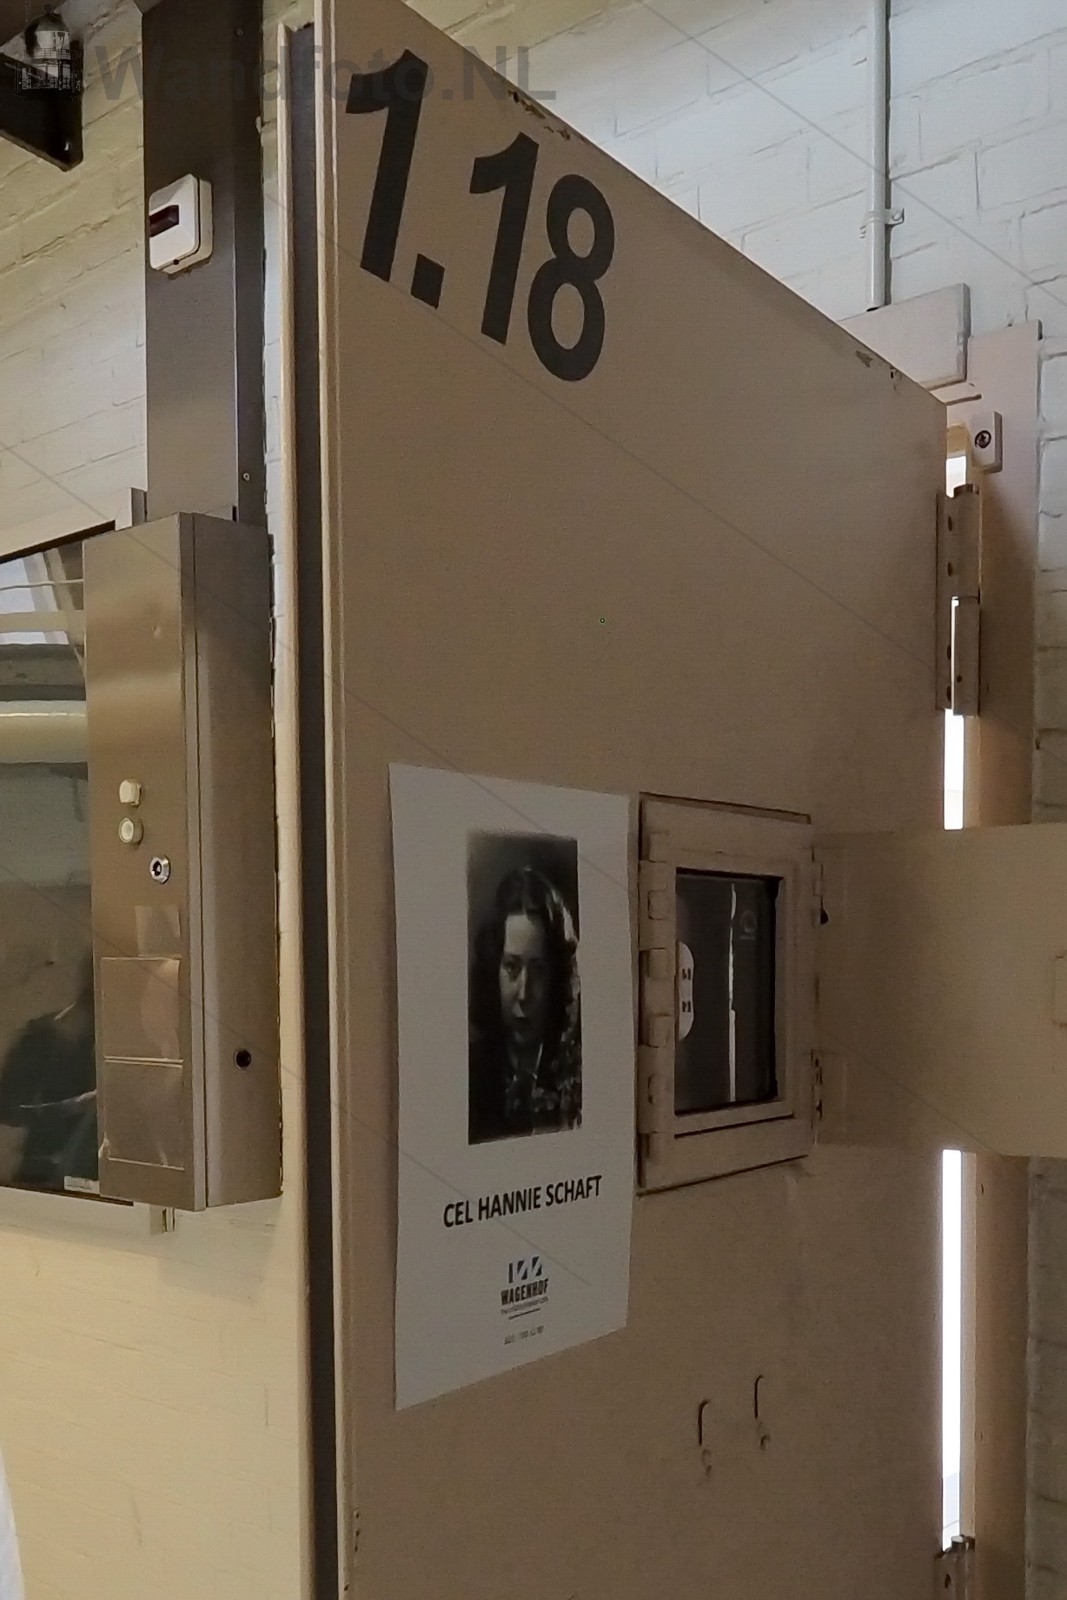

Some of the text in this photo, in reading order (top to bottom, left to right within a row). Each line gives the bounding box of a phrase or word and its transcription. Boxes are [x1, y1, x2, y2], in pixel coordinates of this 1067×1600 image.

[345, 48, 615, 382] 1.18
[443, 1174, 603, 1228] CEL HANNIE SCHAFT
